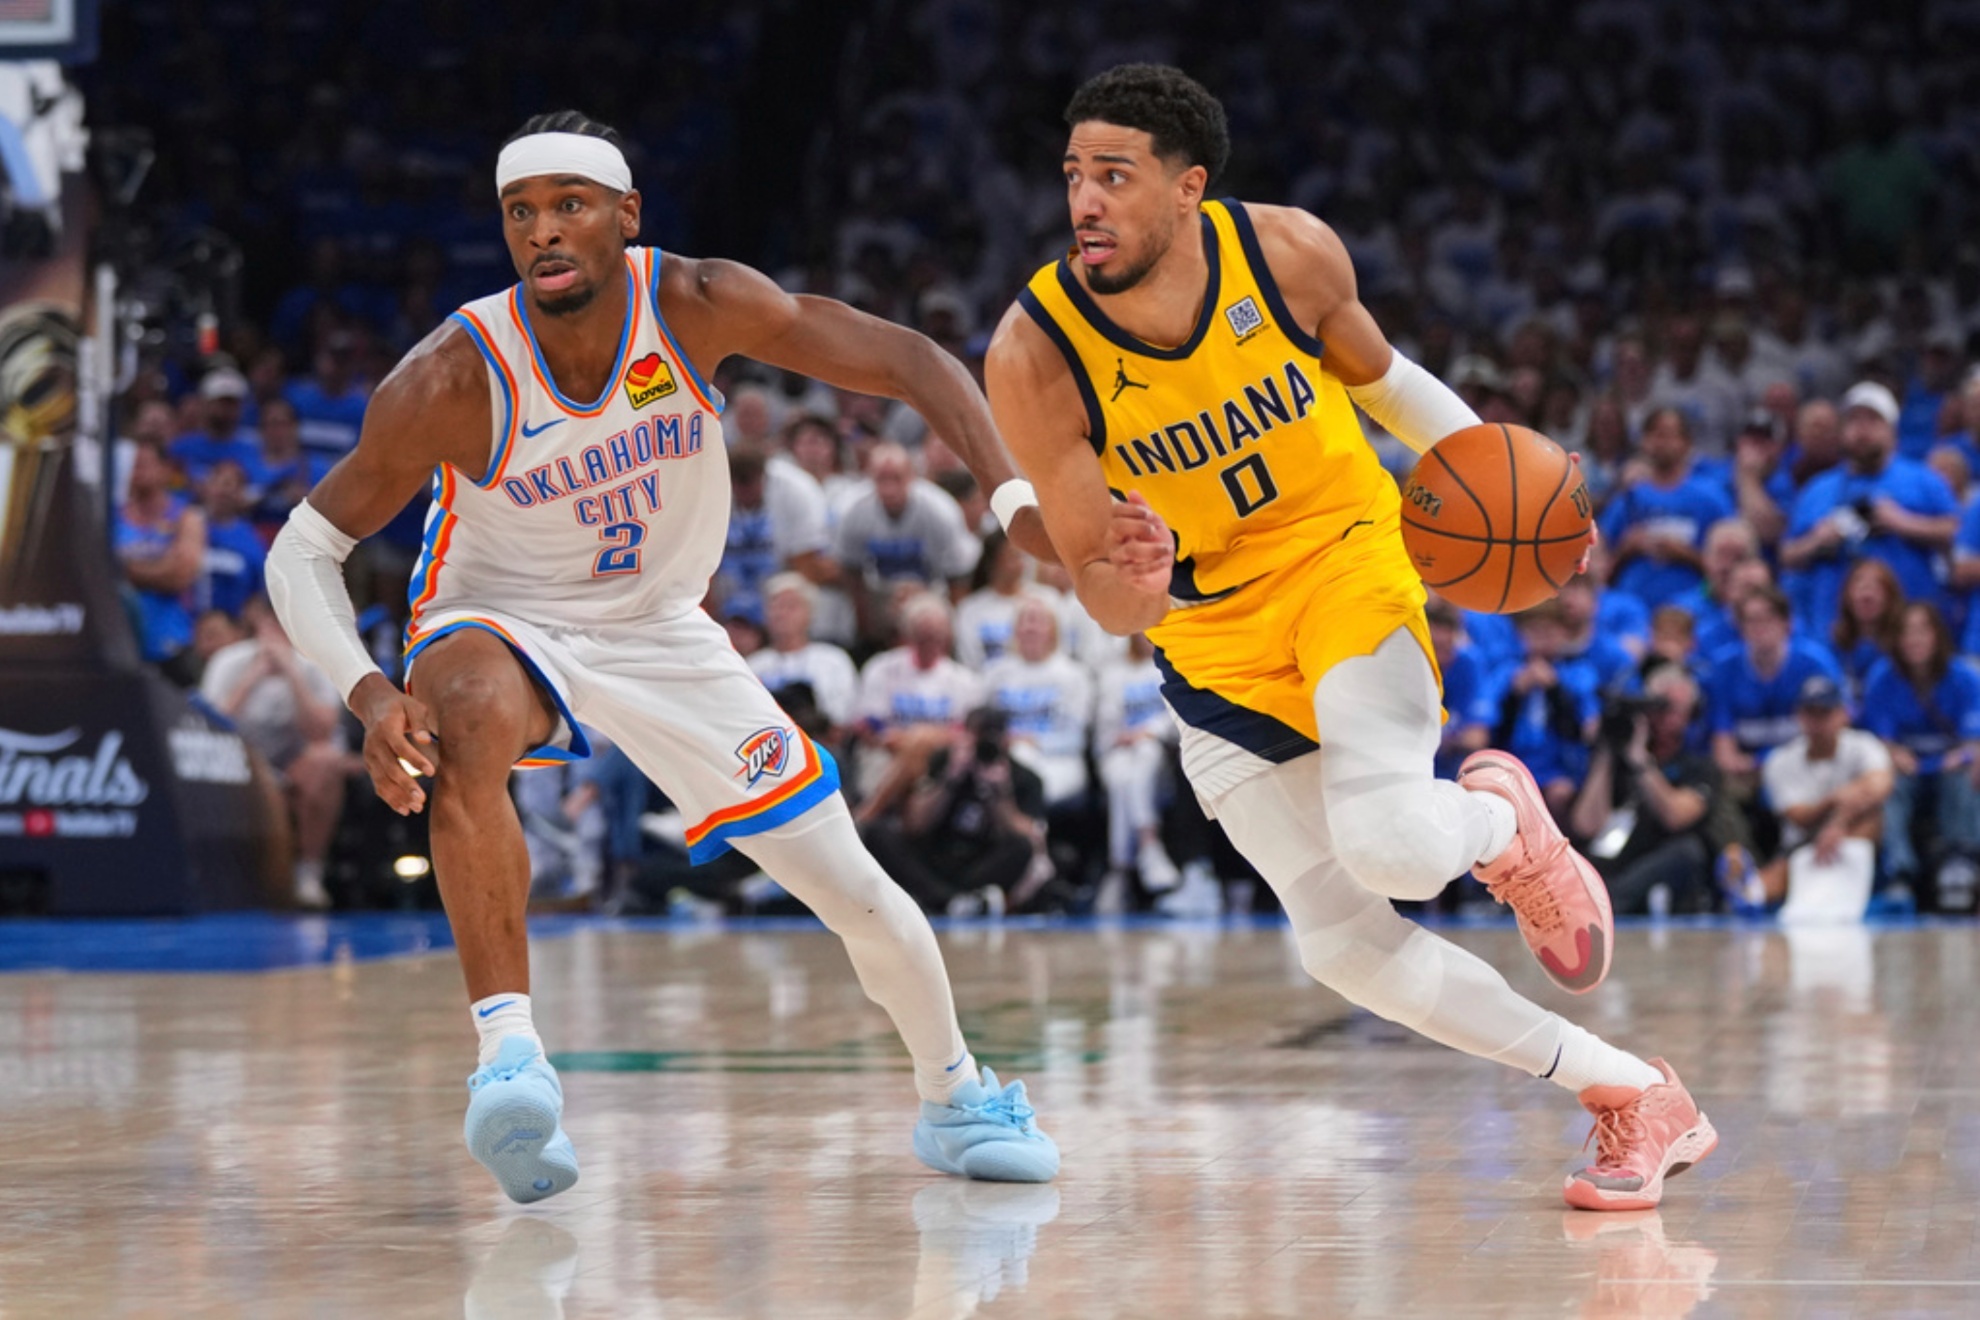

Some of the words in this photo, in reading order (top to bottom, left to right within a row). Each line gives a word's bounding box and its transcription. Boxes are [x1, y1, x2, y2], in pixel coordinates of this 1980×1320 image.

[1114, 361, 1316, 476] INDIANA
[501, 410, 704, 509] OKLAHOMA
[1219, 452, 1279, 519] 0
[573, 469, 662, 527] CITY
[592, 520, 649, 578] 2
